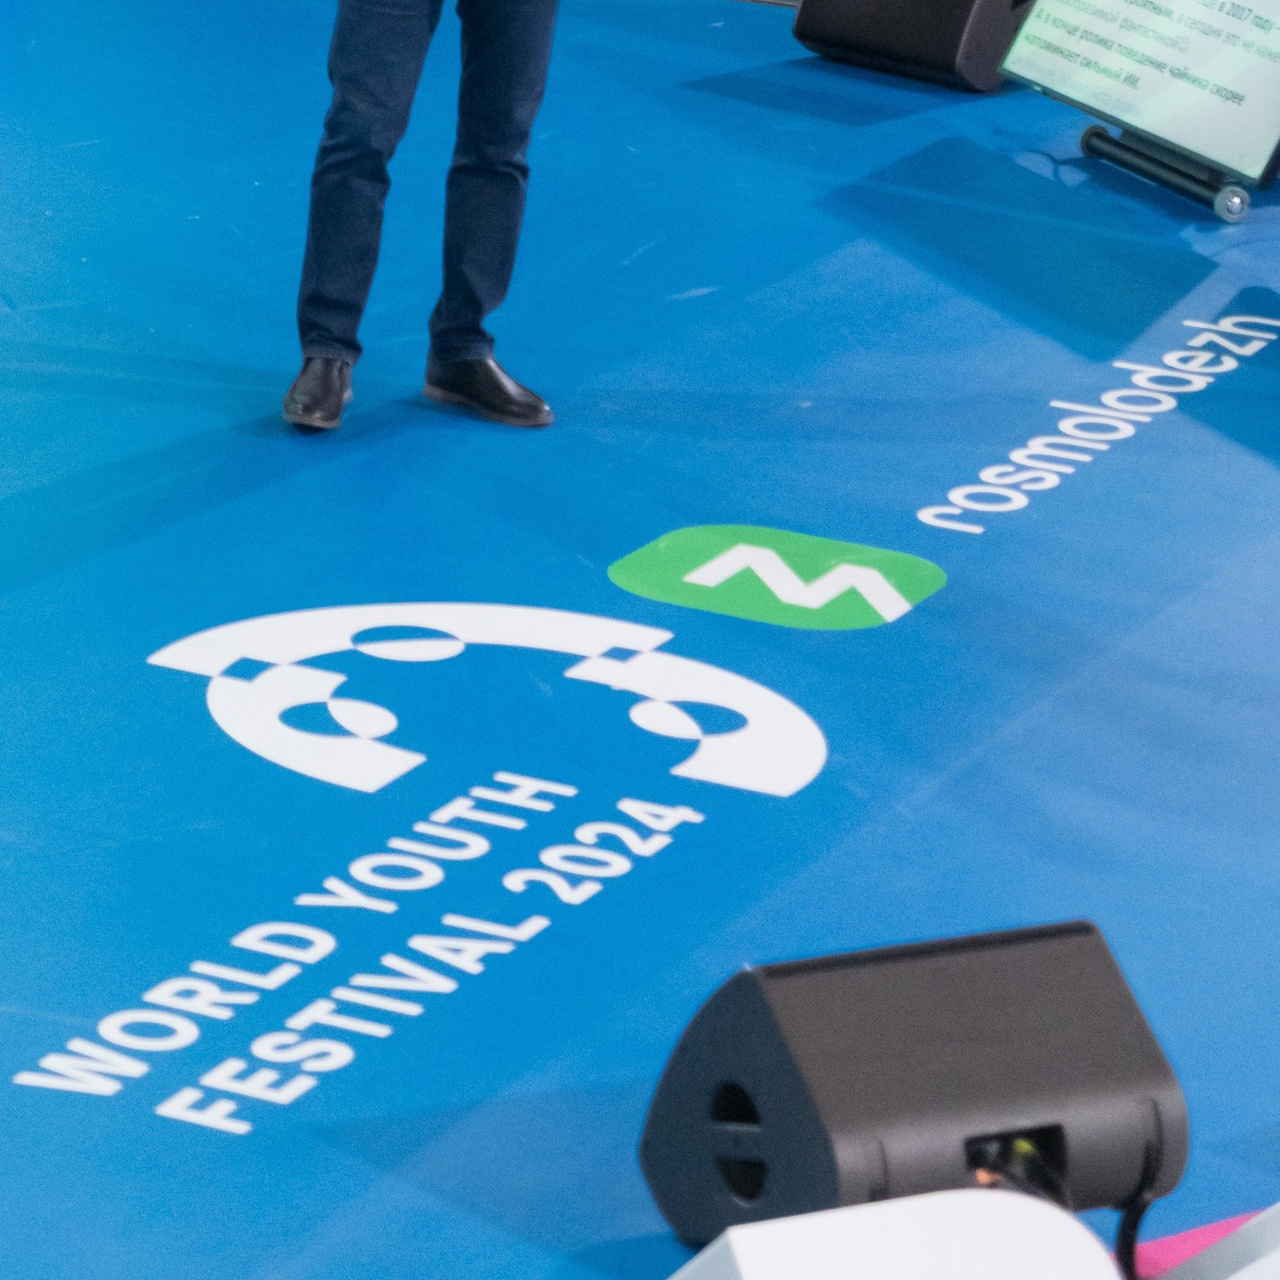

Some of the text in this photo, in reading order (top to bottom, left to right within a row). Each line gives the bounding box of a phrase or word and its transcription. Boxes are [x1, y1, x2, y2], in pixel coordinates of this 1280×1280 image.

[1022, 31, 1081, 64] напоминает
[1078, 52, 1124, 82] сильный
[1048, 16, 1080, 37] конце
[1077, 28, 1115, 53] ролика
[1112, 42, 1168, 74] поведение
[1166, 61, 1212, 91] чайника
[1207, 82, 1246, 109] скорее
[1224, 1, 1253, 23] 2017
[1248, 14, 1275, 35] году
[14, 771, 579, 1098] WORLD YOUTH
[156, 796, 706, 1136] FESTIVAL 2024
